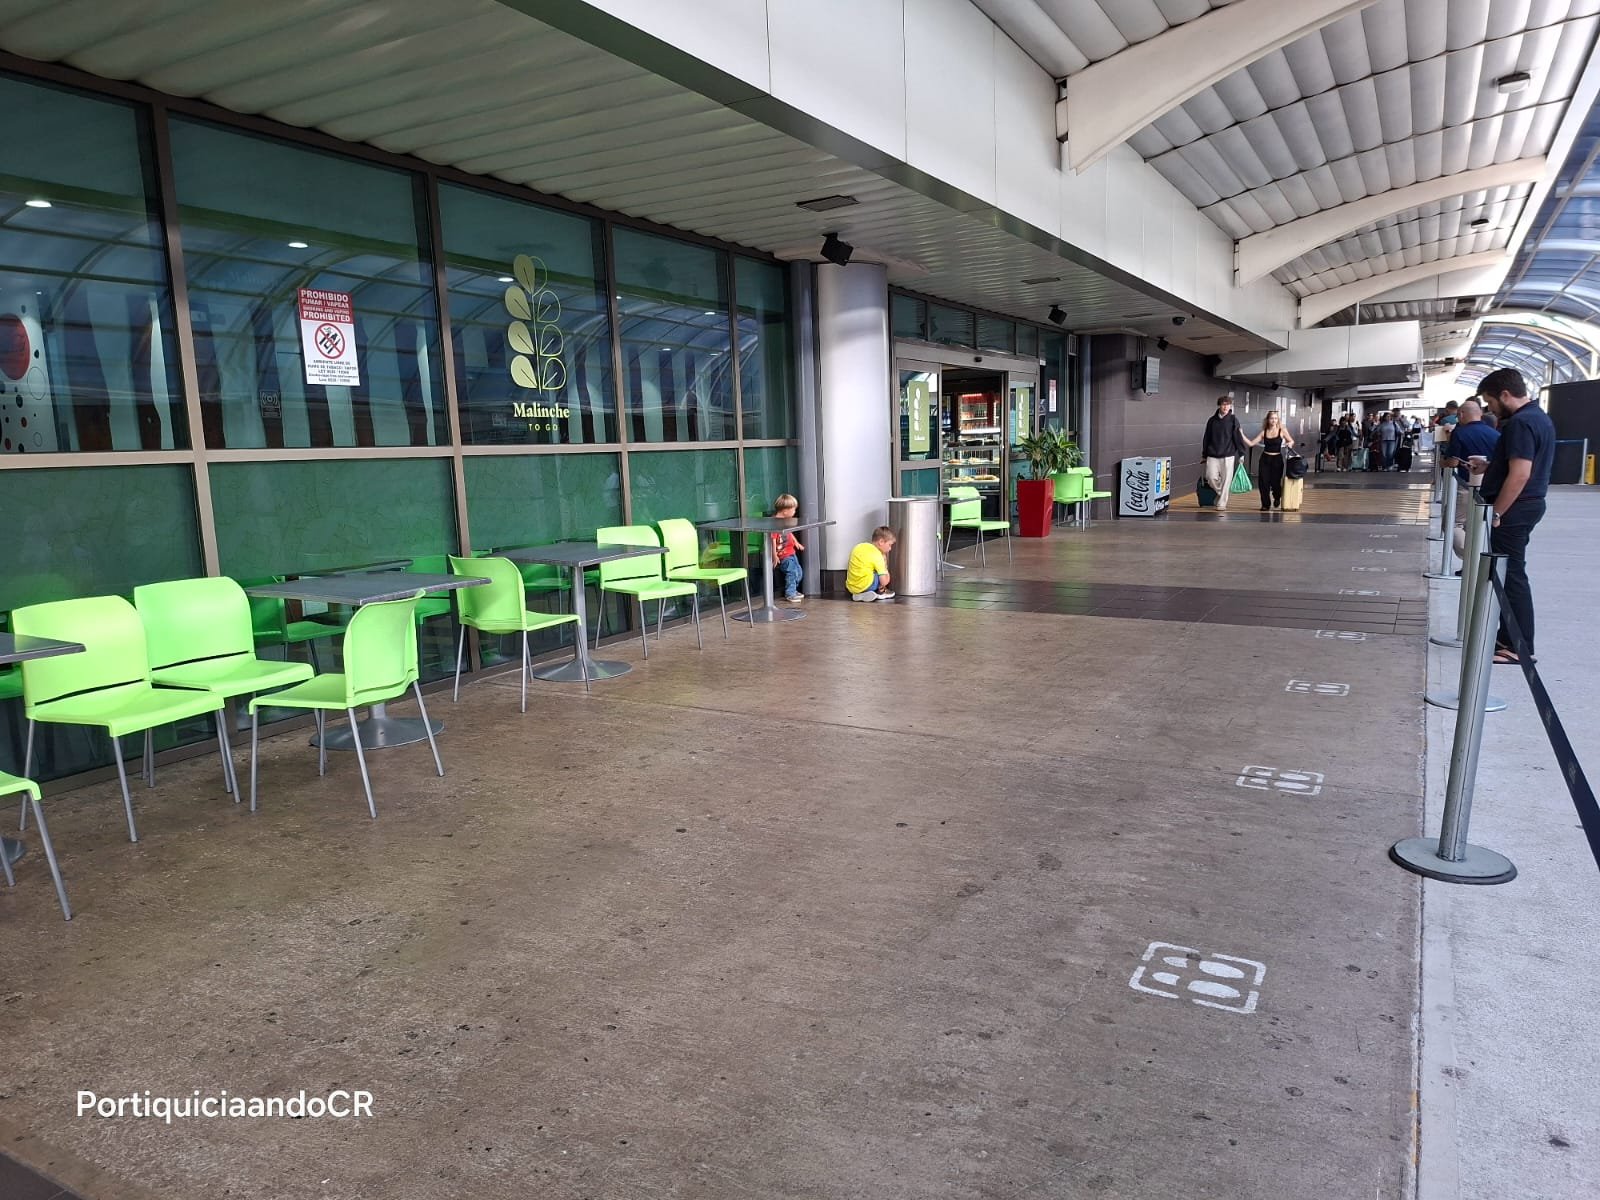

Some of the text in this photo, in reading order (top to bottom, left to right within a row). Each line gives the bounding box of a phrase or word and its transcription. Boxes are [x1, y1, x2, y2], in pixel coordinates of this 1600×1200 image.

[300, 290, 349, 302] PROHIBIDO
[301, 298, 323, 306] FUMAR
[303, 311, 350, 322] PROHIBITED
[513, 402, 570, 418] Malinche
[528, 423, 558, 431] TO GO
